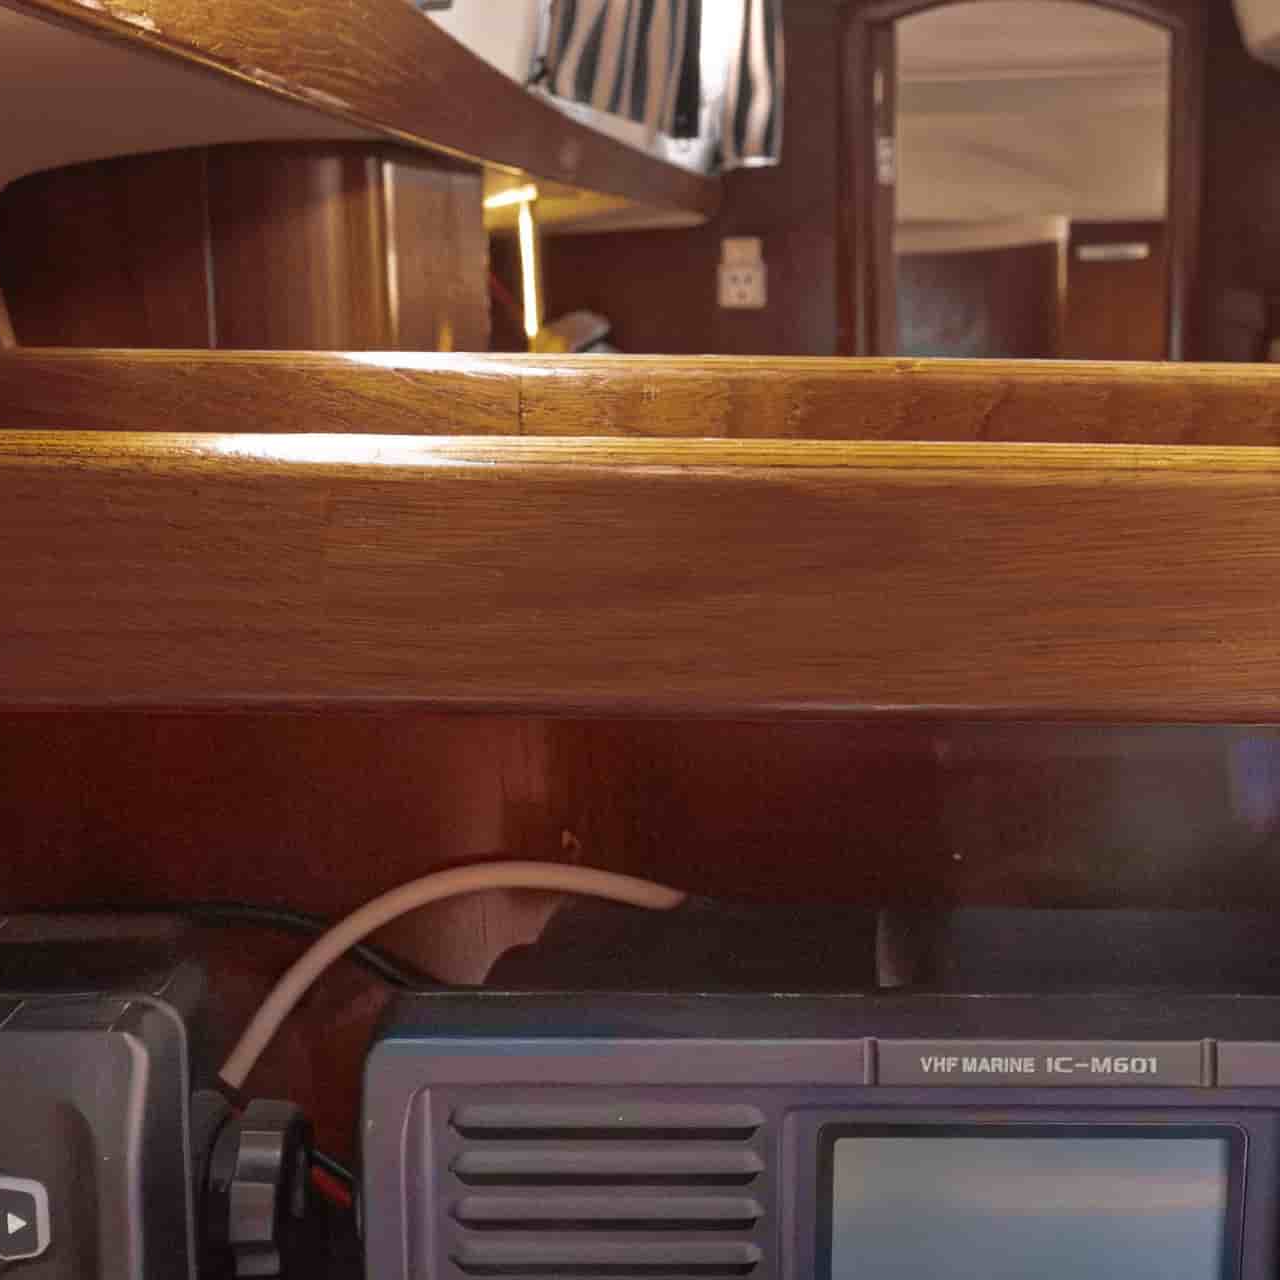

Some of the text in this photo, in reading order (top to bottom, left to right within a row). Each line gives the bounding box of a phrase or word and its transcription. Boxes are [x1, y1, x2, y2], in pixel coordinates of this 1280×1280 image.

[919, 1056, 1158, 1074] VHF MARINE IC-M601
